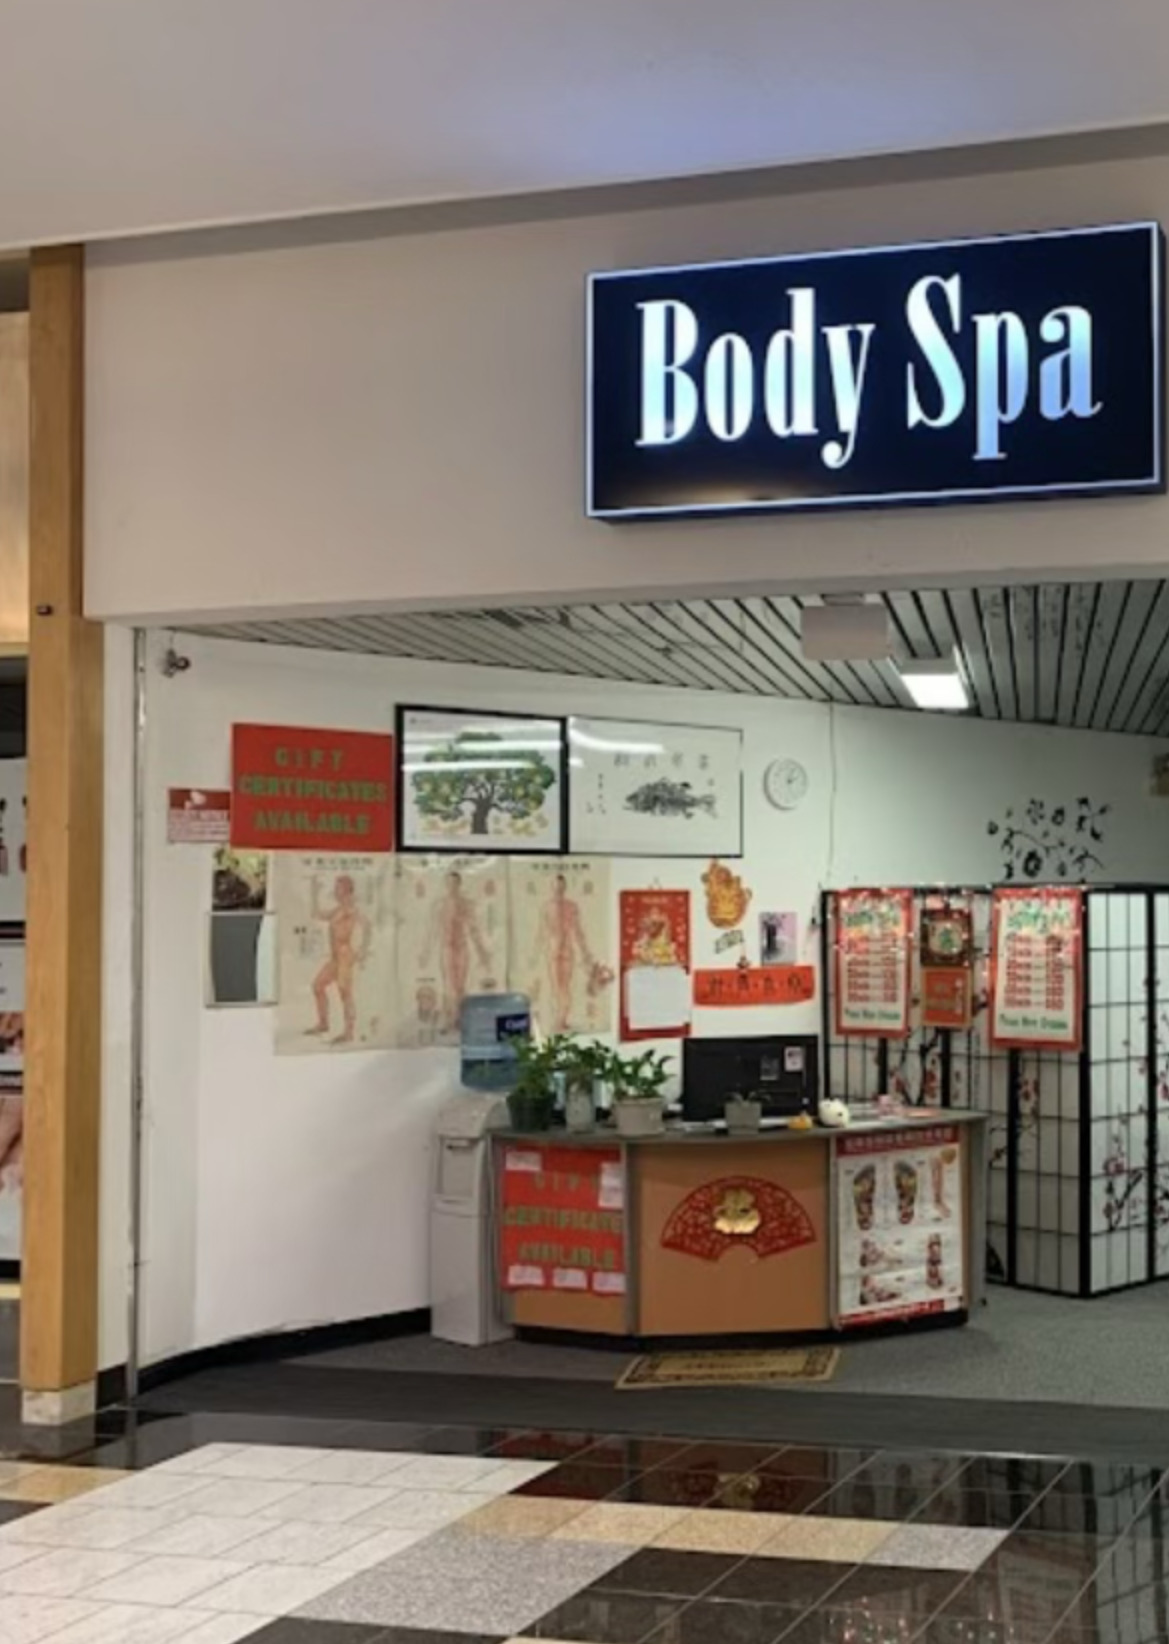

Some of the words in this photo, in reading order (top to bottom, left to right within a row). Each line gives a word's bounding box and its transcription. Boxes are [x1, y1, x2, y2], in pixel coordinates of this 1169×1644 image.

[634, 287, 876, 469] Body
[906, 273, 1103, 461] Spa
[274, 746, 344, 772] GIFT
[238, 773, 388, 803] CERTIFICATES
[253, 810, 371, 836] AVAILABLE
